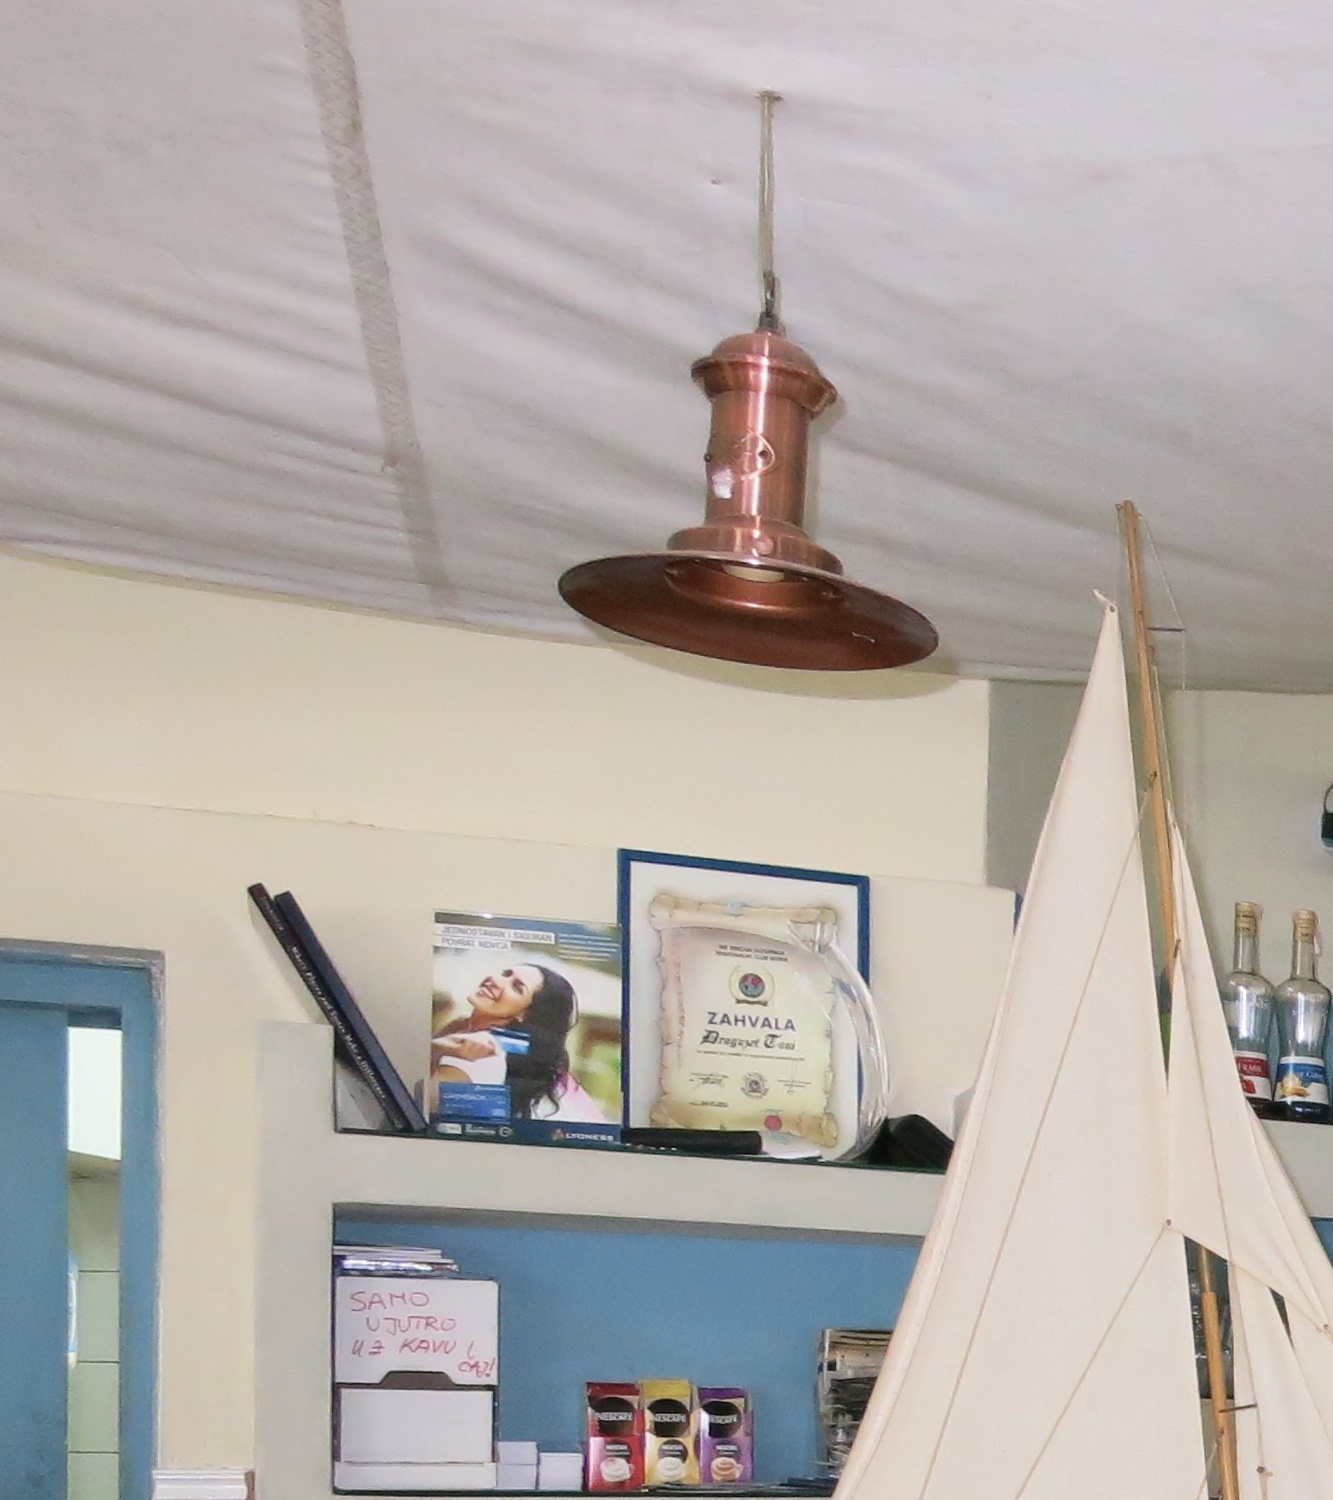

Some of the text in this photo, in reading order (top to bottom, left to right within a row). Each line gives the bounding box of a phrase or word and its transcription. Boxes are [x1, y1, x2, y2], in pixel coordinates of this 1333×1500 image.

[706, 1011, 796, 1031] ZAHVALA
[565, 1132, 616, 1143] LYONESS
[350, 1291, 430, 1313] SAMO
[366, 1315, 456, 1336] UJUTRO
[399, 1337, 457, 1355] KAVU
